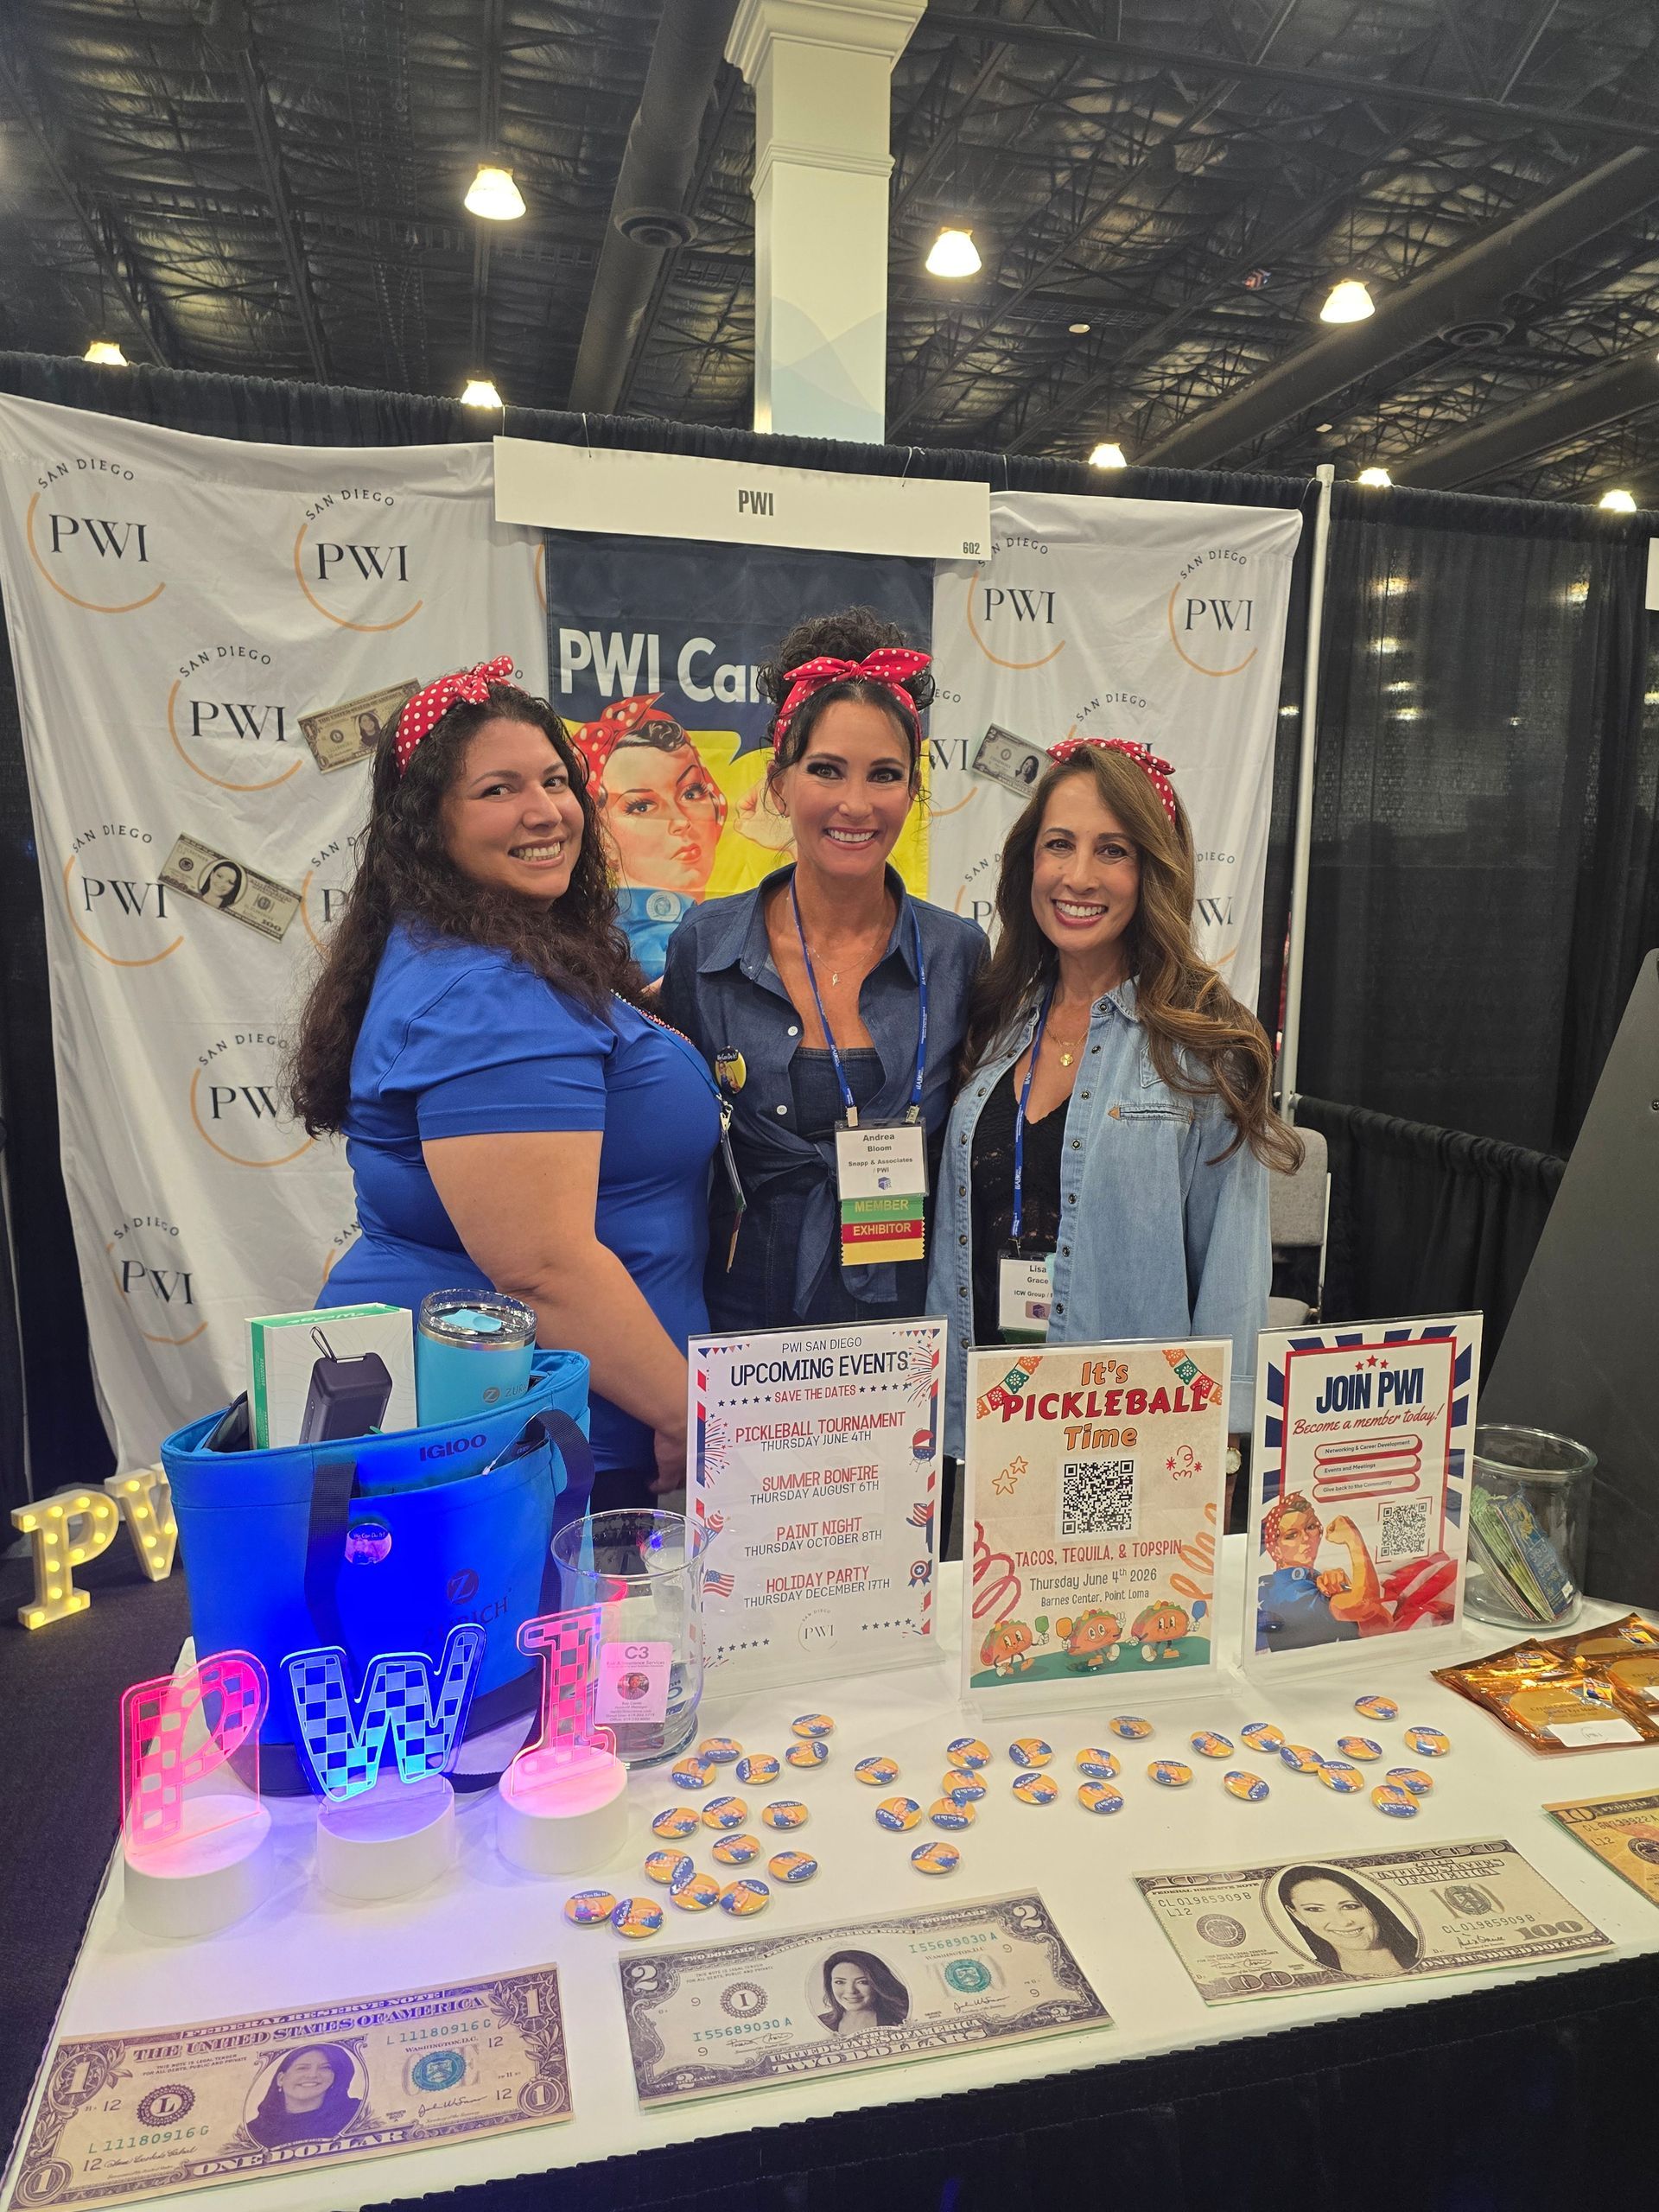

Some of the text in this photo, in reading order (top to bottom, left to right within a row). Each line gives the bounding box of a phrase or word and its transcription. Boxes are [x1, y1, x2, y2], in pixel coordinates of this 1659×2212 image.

[37, 458, 135, 490] SAN DIEGO
[305, 488, 396, 521] SAN DIEGO
[738, 489, 774, 517] PWI
[49, 513, 149, 563] PWI
[963, 542, 981, 555] 602
[1007, 537, 1049, 555] DIEGO
[315, 543, 409, 582] PWI
[1180, 550, 1248, 580] SAN DIEGO
[983, 588, 1056, 625] PWI
[1185, 598, 1254, 632] PWI
[180, 645, 271, 677] SAN DIEGO
[558, 628, 659, 698] PWI
[190, 700, 287, 742] PWI
[1076, 694, 1147, 722] SAN DIEGO
[73, 823, 153, 854] SAN DIEGO
[311, 841, 340, 868] SAN
[1197, 852, 1235, 863] DIEGO
[964, 858, 989, 882] SAN
[82, 876, 168, 918] PWI
[199, 1033, 289, 1066] SAN DIEGO
[211, 1085, 283, 1119] PW
[862, 1133, 895, 1142] Andrea
[855, 1199, 909, 1213] MEMBER
[853, 1222, 912, 1236] EXHIBITOR
[121, 1260, 194, 1305] PWI
[1027, 1276, 1048, 1285] Grace
[1029, 1265, 1047, 1274] Lisa
[782, 1337, 862, 1354] PWI SAN DIEGO
[731, 1351, 908, 1387] UPCOMING EVENTS
[774, 1384, 856, 1403] SAVE THE DATES
[1001, 1384, 1209, 1424] PICKLEBALL
[1316, 1368, 1424, 1414] JOIN PWI
[735, 1411, 906, 1443] PICKLEBALL TOURNAMENT
[1293, 1402, 1446, 1435] Become a member today!
[419, 1434, 487, 1461] IGLOO
[761, 1430, 872, 1452] THURSDAY JUNE 4TH
[1064, 1421, 1138, 1451] Time
[1325, 1446, 1355, 1455] Networking
[1377, 1440, 1410, 1449] Development
[762, 1465, 879, 1491] SUMMER BONFIRE
[1363, 1479, 1392, 1488] Community
[750, 1482, 879, 1505] THURSDAY AUGUST 6TH
[777, 1516, 863, 1541] PAINT NIGHT
[744, 1529, 882, 1557] THURSDAY OCTOBER 8TH
[1015, 1539, 1182, 1567] TACOS, TEQUILA, & TOPSPIN
[744, 1579, 891, 1608] THURSDAY DECEMBER 17TH
[766, 1566, 870, 1593] HOLIDAY PARTY
[1030, 1567, 1157, 1592] Thursday June 4th 2026
[1041, 1594, 1070, 1607] Barnes
[1104, 1588, 1126, 1601] Point
[1128, 1587, 1149, 1599] Loma
[804, 1624, 835, 1640] PWI
[625, 1645, 649, 1659] C3
[1515, 1920, 1583, 1941] 100
[631, 1965, 659, 1993] 2
[182, 1991, 442, 2039] FEDERAL RESERVE NOTE
[523, 1989, 543, 2019] 1
[133, 1995, 490, 2063] THE UNITED STATES OF AMERICA
[705, 2018, 780, 2040] 55689030
[784, 2017, 792, 2027] A
[89, 2142, 98, 2154] L
[105, 2126, 196, 2152] 11180916
[192, 2130, 407, 2177] ONE DOLLAR
